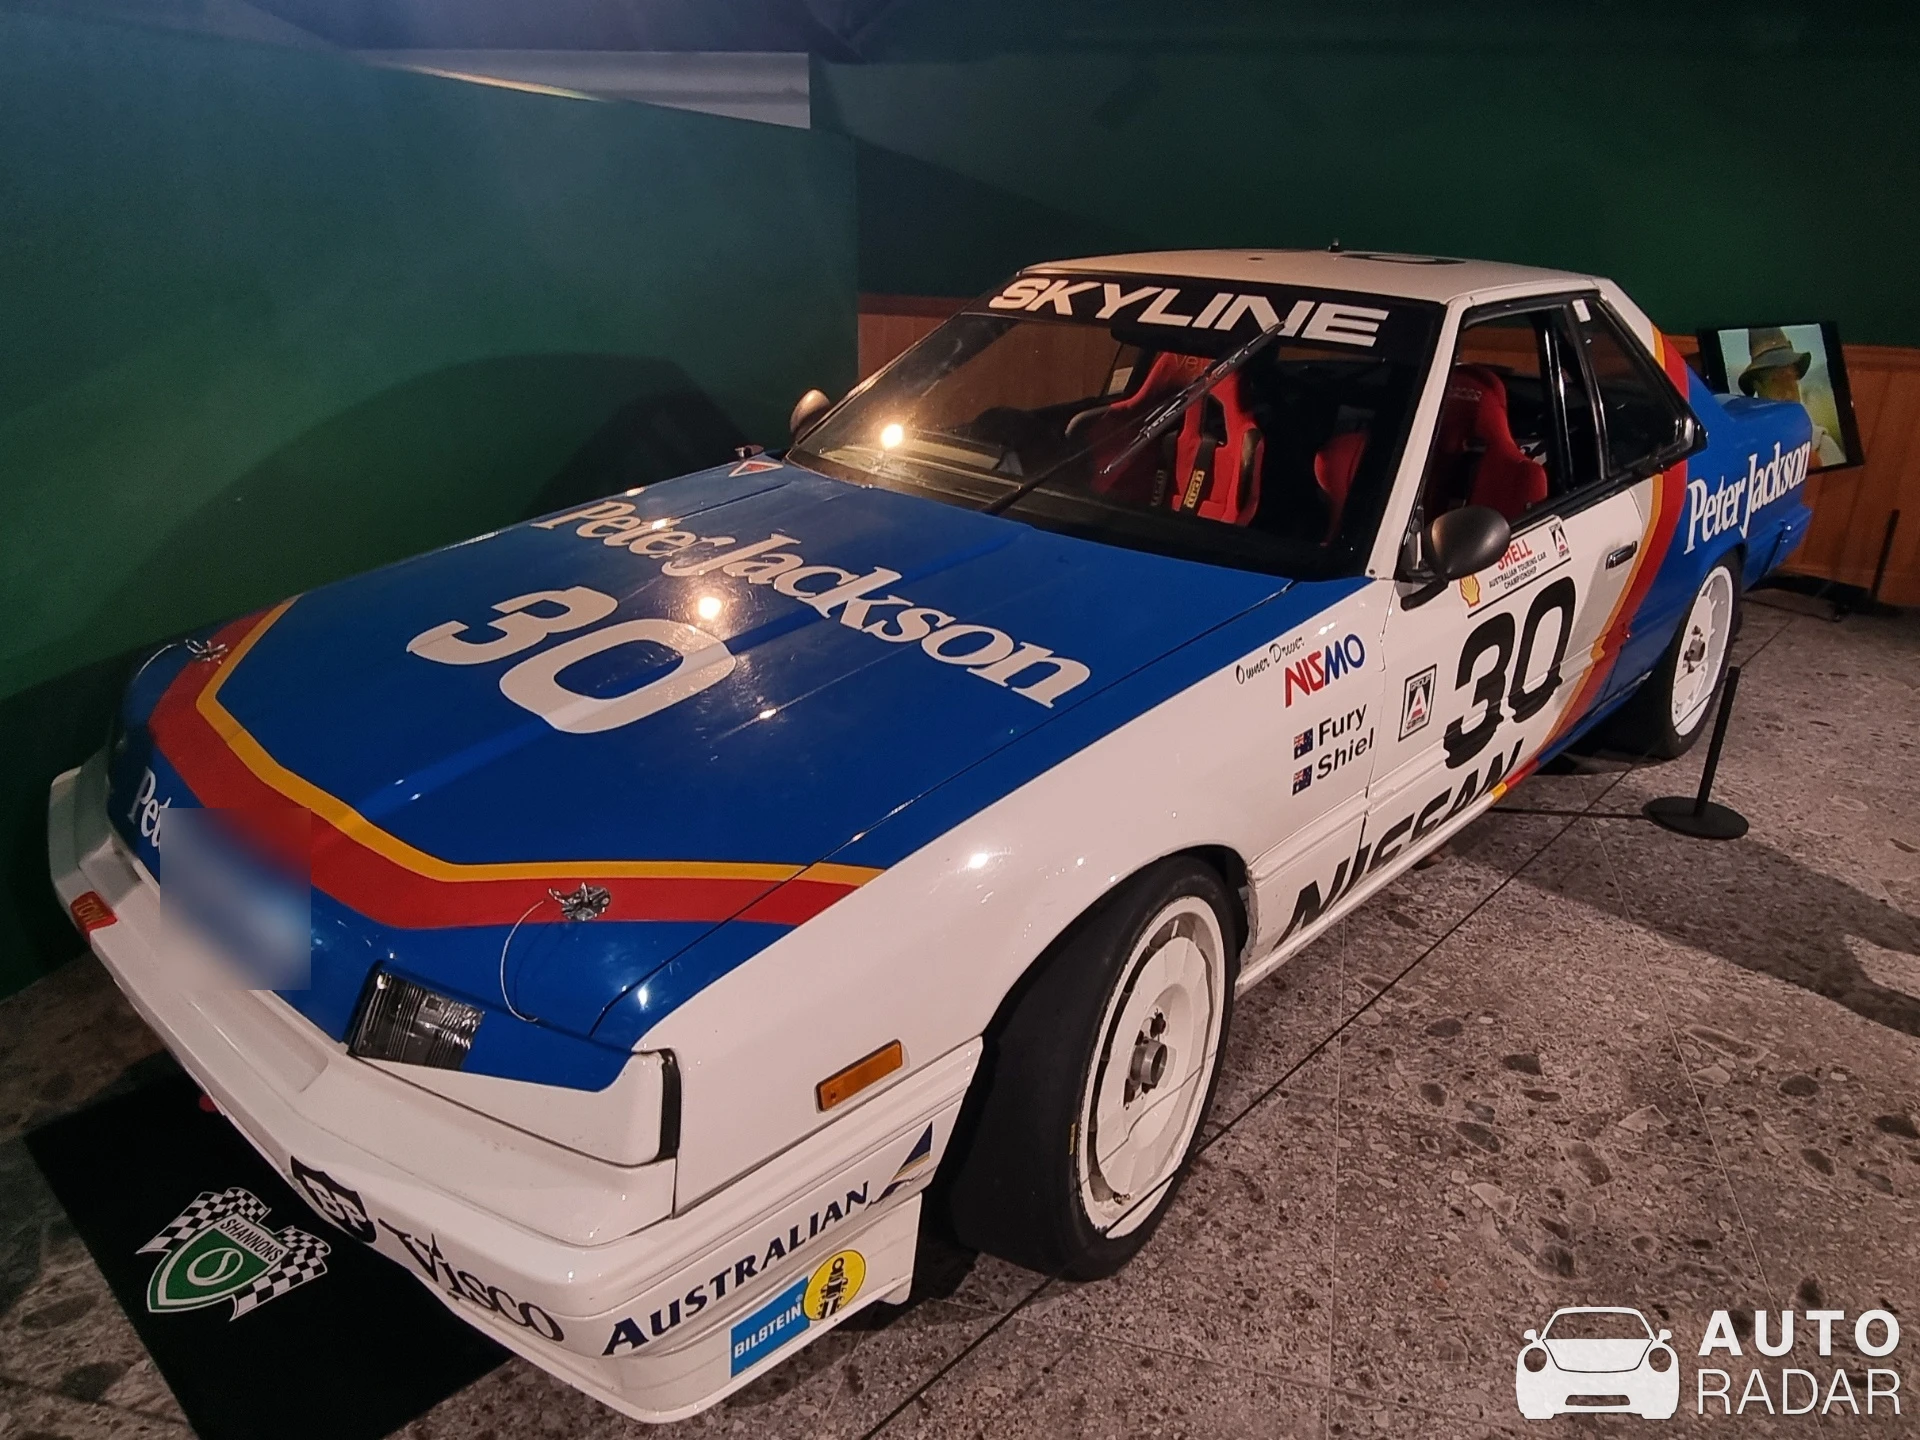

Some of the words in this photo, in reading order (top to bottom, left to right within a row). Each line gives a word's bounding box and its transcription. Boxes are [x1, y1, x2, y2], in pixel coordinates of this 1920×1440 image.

[988, 278, 1389, 347] SKYLINE
[1684, 475, 1746, 556] Peter
[1739, 441, 1812, 539] Jackson
[529, 500, 736, 559] Peter
[662, 533, 1090, 709] Jackson
[1489, 568, 1518, 588] AUSTRALIAN
[1518, 558, 1538, 572] TOURING
[1537, 552, 1547, 562] CAR
[1504, 566, 1537, 589] CHAMPIONSHIP
[406, 585, 737, 734] 30
[1235, 657, 1270, 684] Owner
[1285, 633, 1365, 708] NISMO
[1443, 576, 1576, 770] 30
[1316, 727, 1375, 780] Shiel
[1318, 703, 1367, 746] Fury
[127, 766, 171, 853] Pet
[302, 1174, 367, 1232] BP
[220, 1218, 284, 1264] SHANNONS
[601, 1180, 869, 1356] AUSTRALIAN
[378, 1217, 565, 1343] VISCO
[733, 1301, 803, 1359] BILSTEIN
